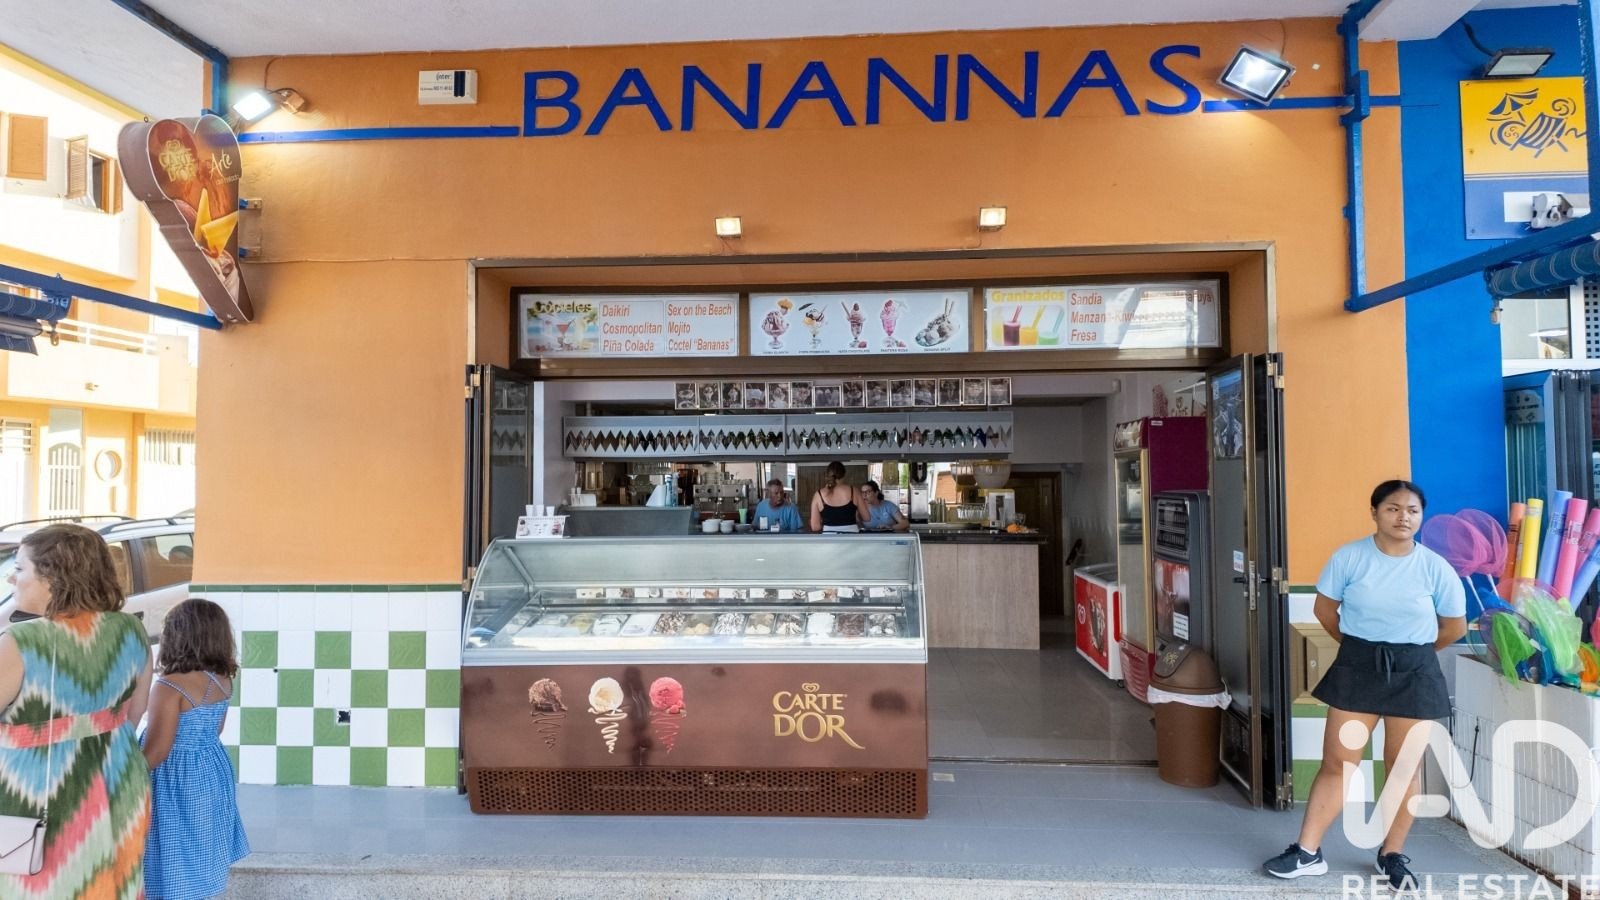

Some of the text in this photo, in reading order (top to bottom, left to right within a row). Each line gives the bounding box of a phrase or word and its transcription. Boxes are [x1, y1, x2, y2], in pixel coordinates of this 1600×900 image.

[523, 45, 1203, 137] BANANNAS
[210, 149, 233, 179] Arte
[992, 288, 1066, 304] Granizados
[602, 304, 630, 317] Daikiri
[667, 303, 732, 316] Sex on the Beach
[602, 321, 663, 337] Cosmopolitan
[667, 321, 691, 337] Mojito
[1070, 329, 1097, 342] Fresa
[602, 339, 655, 352] Piña Colada
[667, 339, 692, 351] Coctel
[772, 691, 845, 714] CARTE
[773, 710, 866, 750] D'OR
